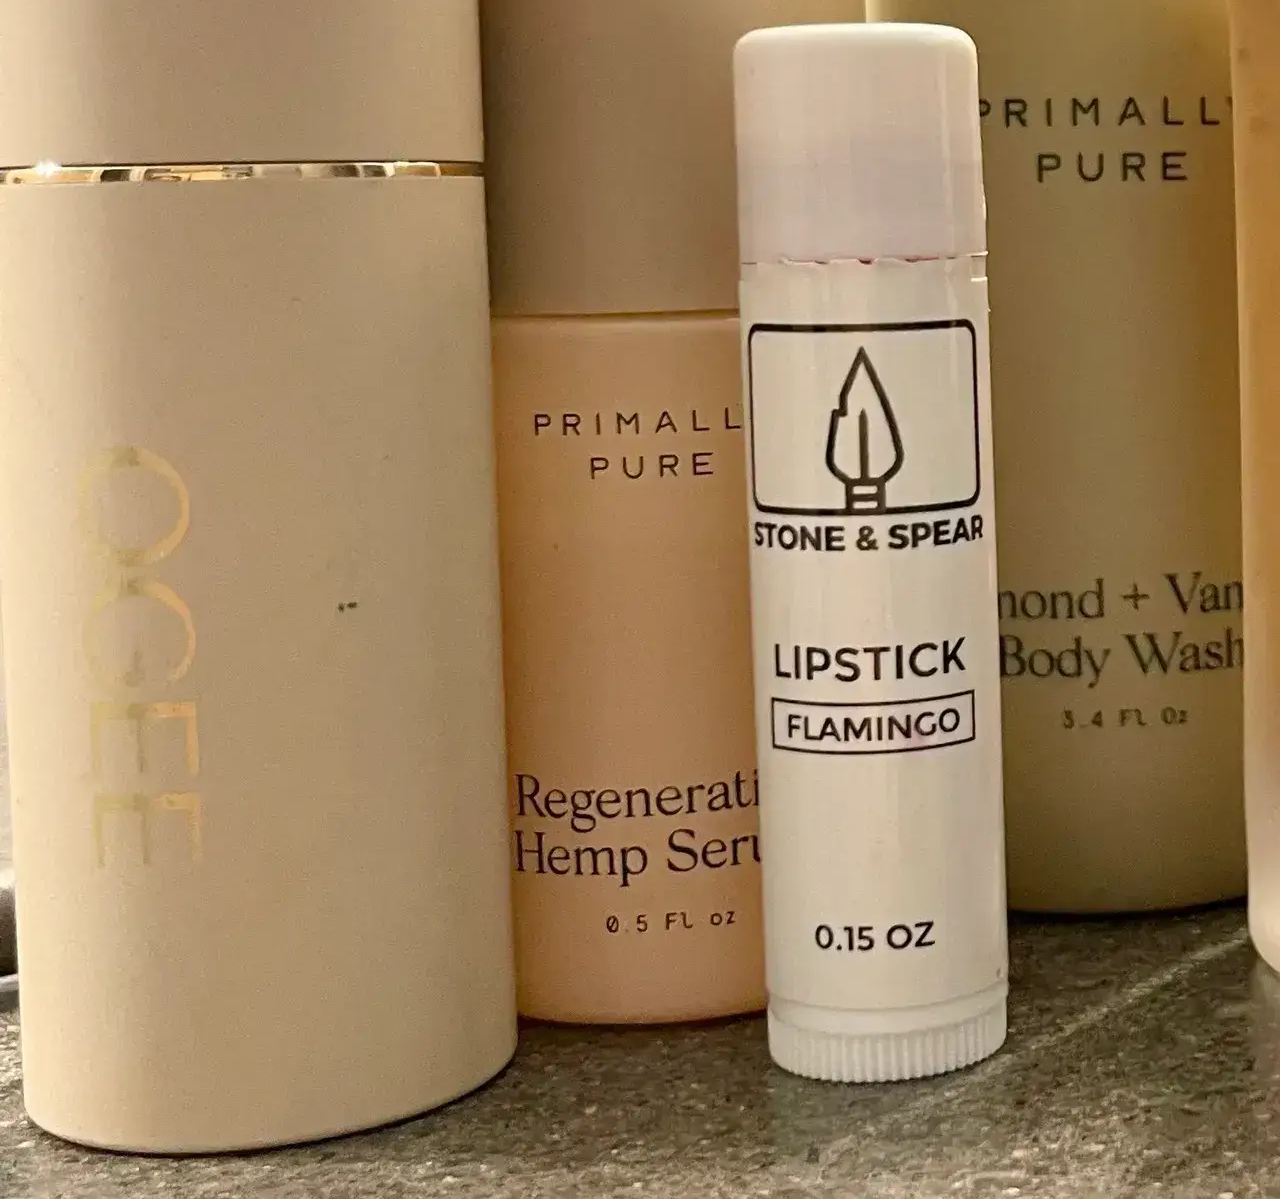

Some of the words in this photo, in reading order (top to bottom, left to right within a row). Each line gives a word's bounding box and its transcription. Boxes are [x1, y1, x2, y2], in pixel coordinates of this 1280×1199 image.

[979, 96, 1233, 128] PRIMALL
[1037, 152, 1188, 183] PURE
[534, 407, 742, 436] PRIMALL
[590, 452, 714, 479] PURE
[754, 522, 846, 551] STONE
[855, 525, 879, 551] &
[888, 514, 984, 550] SPEAR
[1163, 571, 1244, 614] Van
[76, 445, 203, 869] OGEE
[774, 636, 967, 682] LIPSTICK
[1000, 634, 1112, 689] Body
[1123, 625, 1244, 675] Wash
[787, 708, 960, 742] FLAMINGO
[515, 768, 760, 833] Regenerati
[514, 829, 648, 887] Hemp
[606, 914, 648, 933] 0.5
[815, 924, 875, 951] 0.15
[886, 920, 936, 949] OZ
